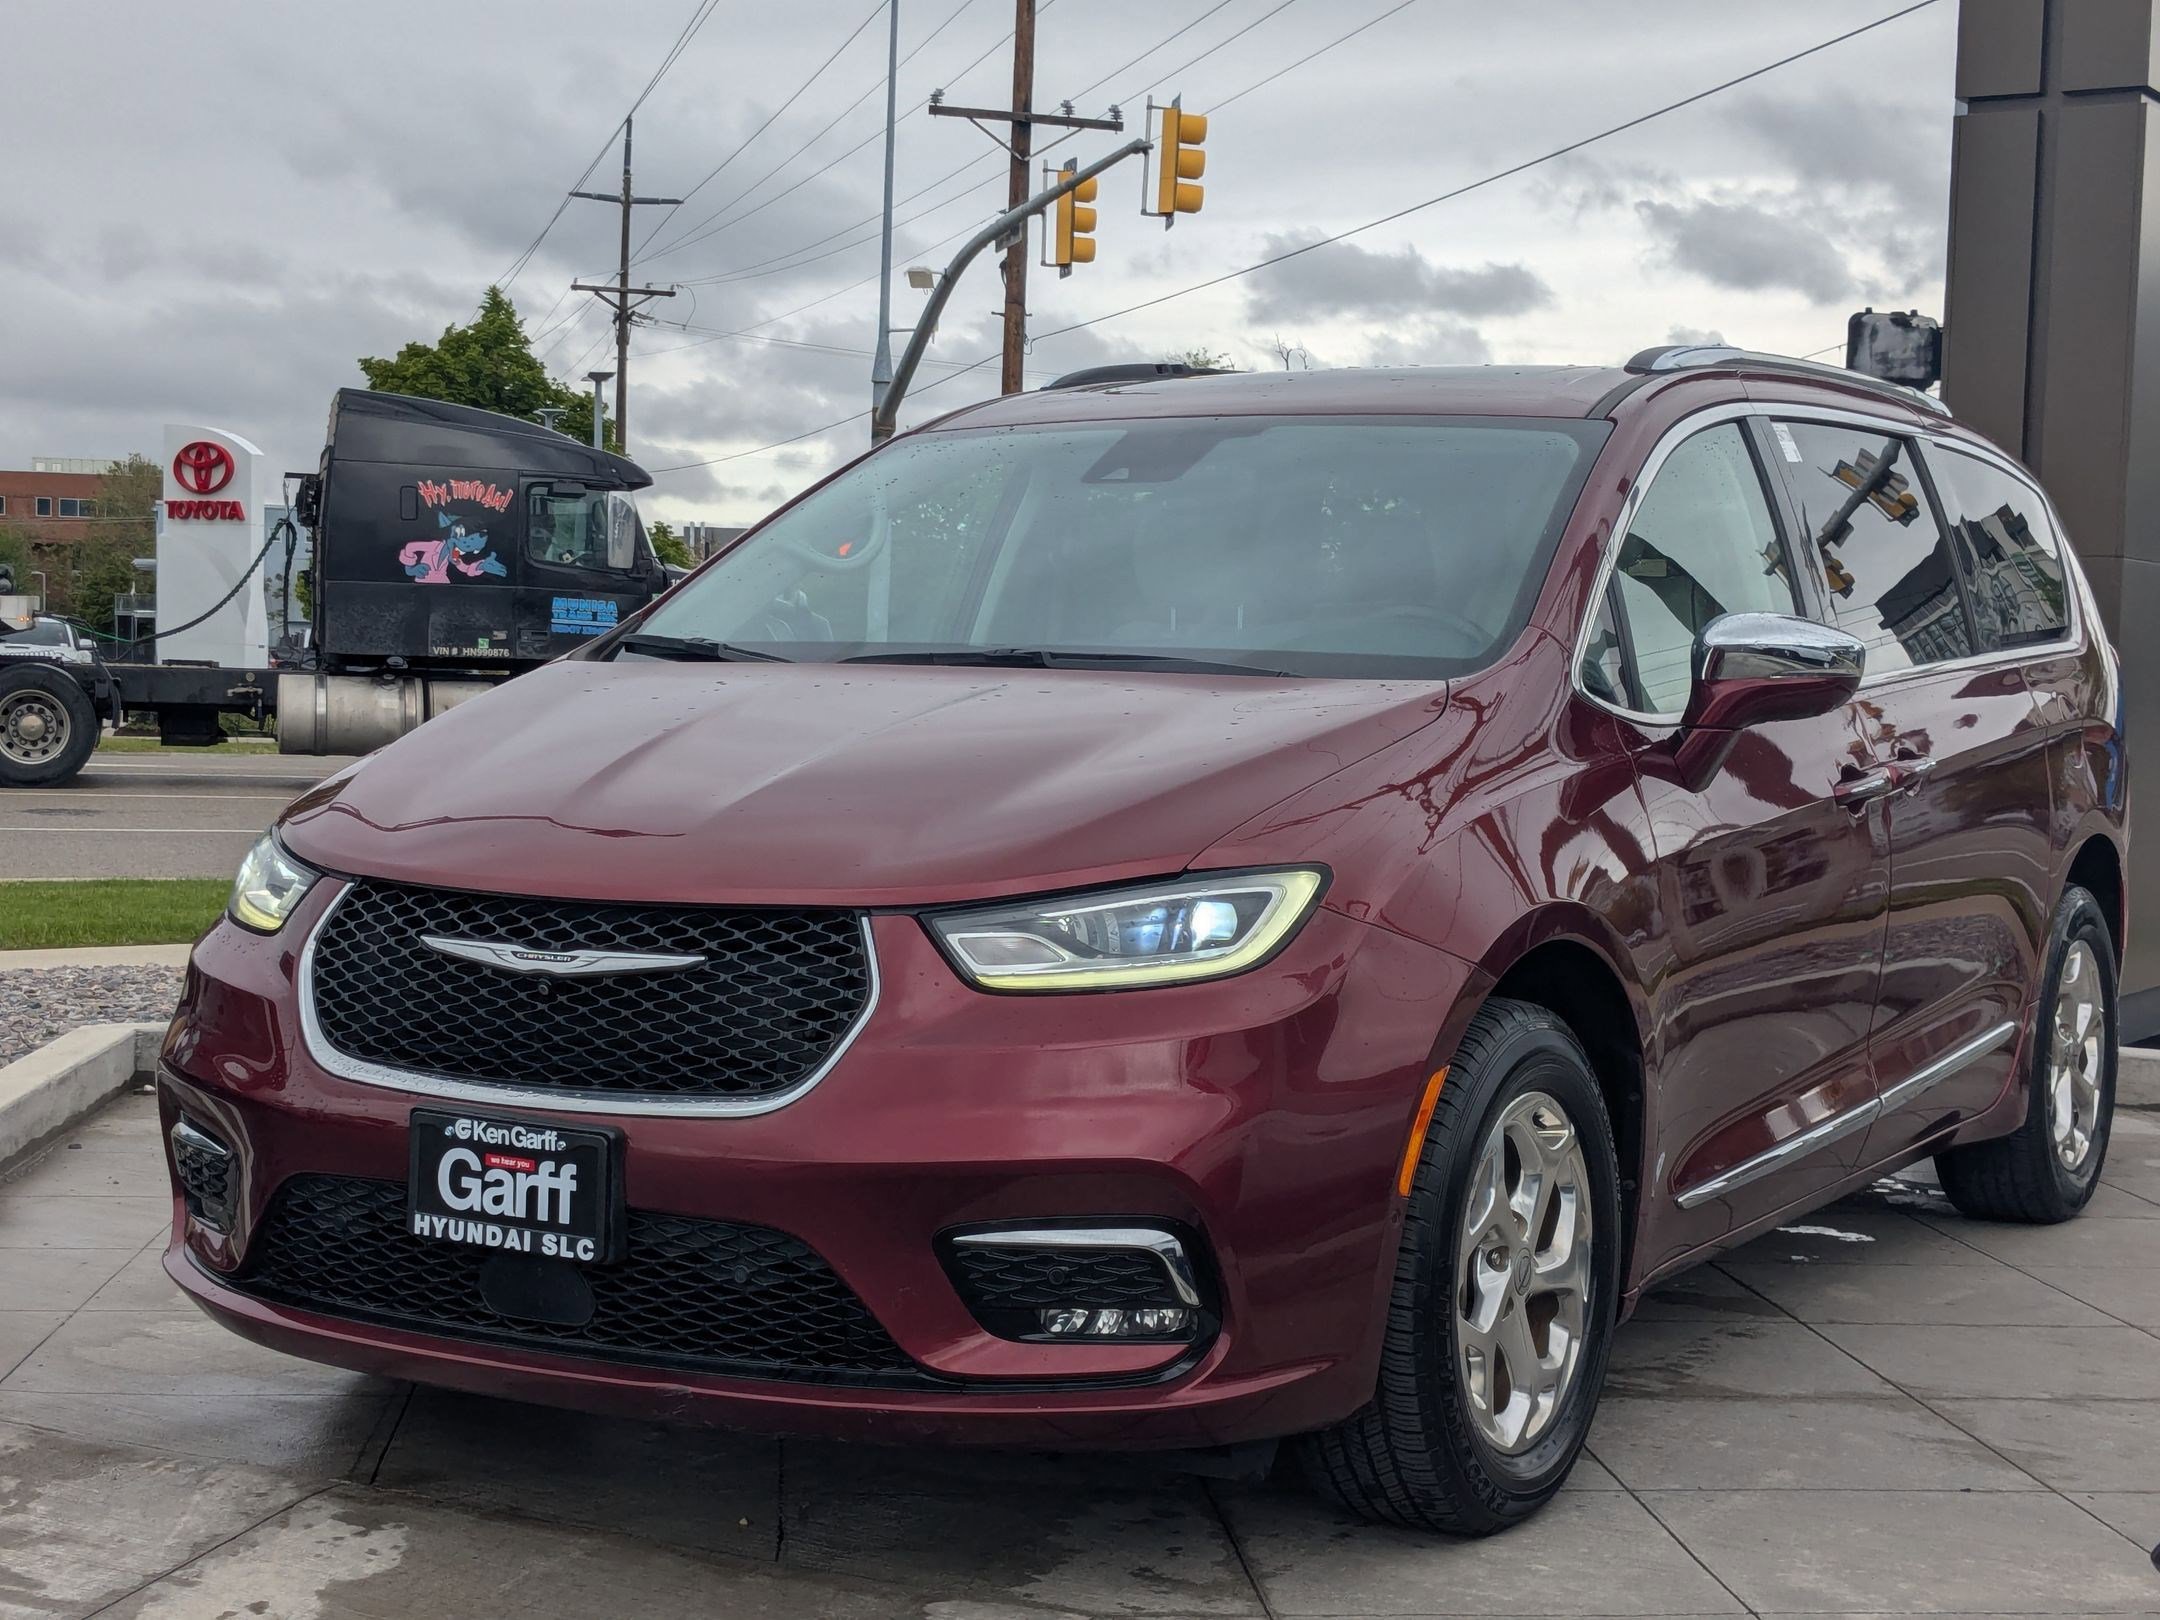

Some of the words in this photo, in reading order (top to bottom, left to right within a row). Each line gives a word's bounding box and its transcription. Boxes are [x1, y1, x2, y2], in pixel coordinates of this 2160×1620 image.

[165, 500, 246, 521] TOYOTA
[432, 646, 449, 655] VIN
[451, 647, 458, 656] #
[516, 952, 572, 962] CHRYSLER
[490, 1156, 500, 1164] we
[501, 1156, 516, 1167] hear
[517, 1159, 530, 1169] you
[437, 1147, 577, 1225] Garff
[414, 1213, 531, 1252] HYUNDAI
[541, 1233, 595, 1261] SLC
